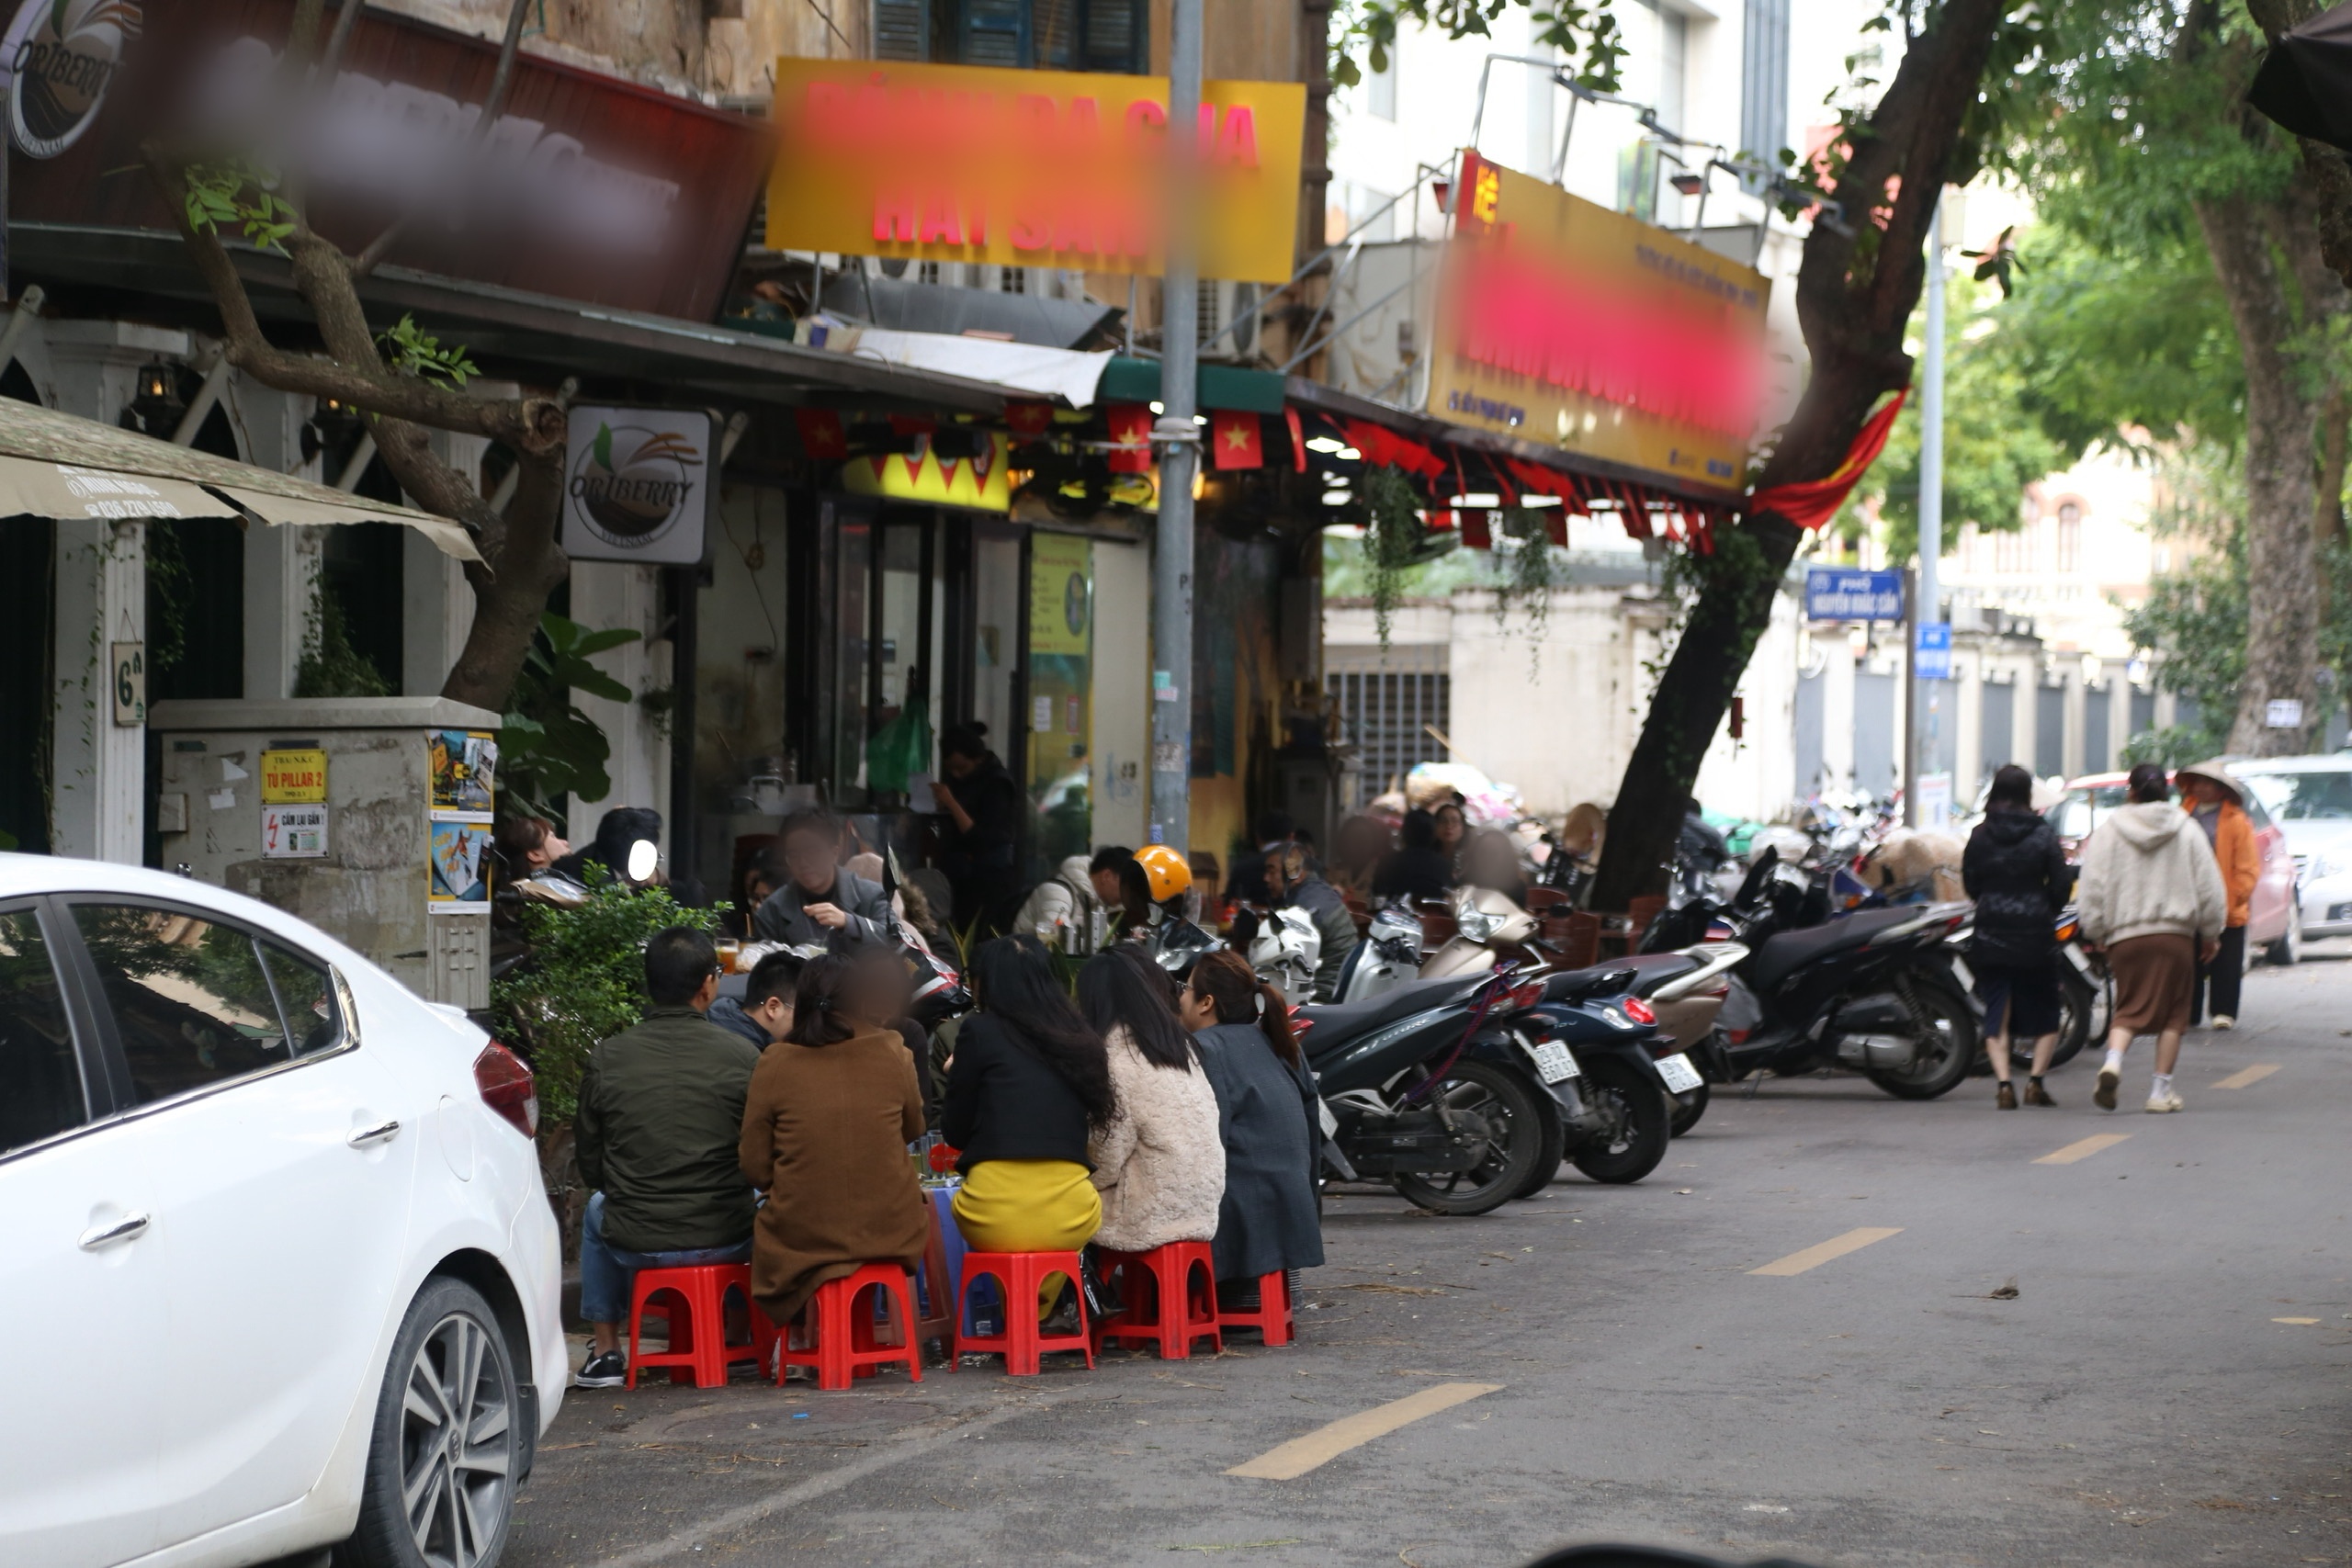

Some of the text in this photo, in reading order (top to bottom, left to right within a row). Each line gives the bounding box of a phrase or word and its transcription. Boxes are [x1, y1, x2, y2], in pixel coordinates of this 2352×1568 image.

[570, 475, 693, 506] ORIBERRY
[281, 772, 313, 787] PILLAR
[316, 772, 322, 786] 2
